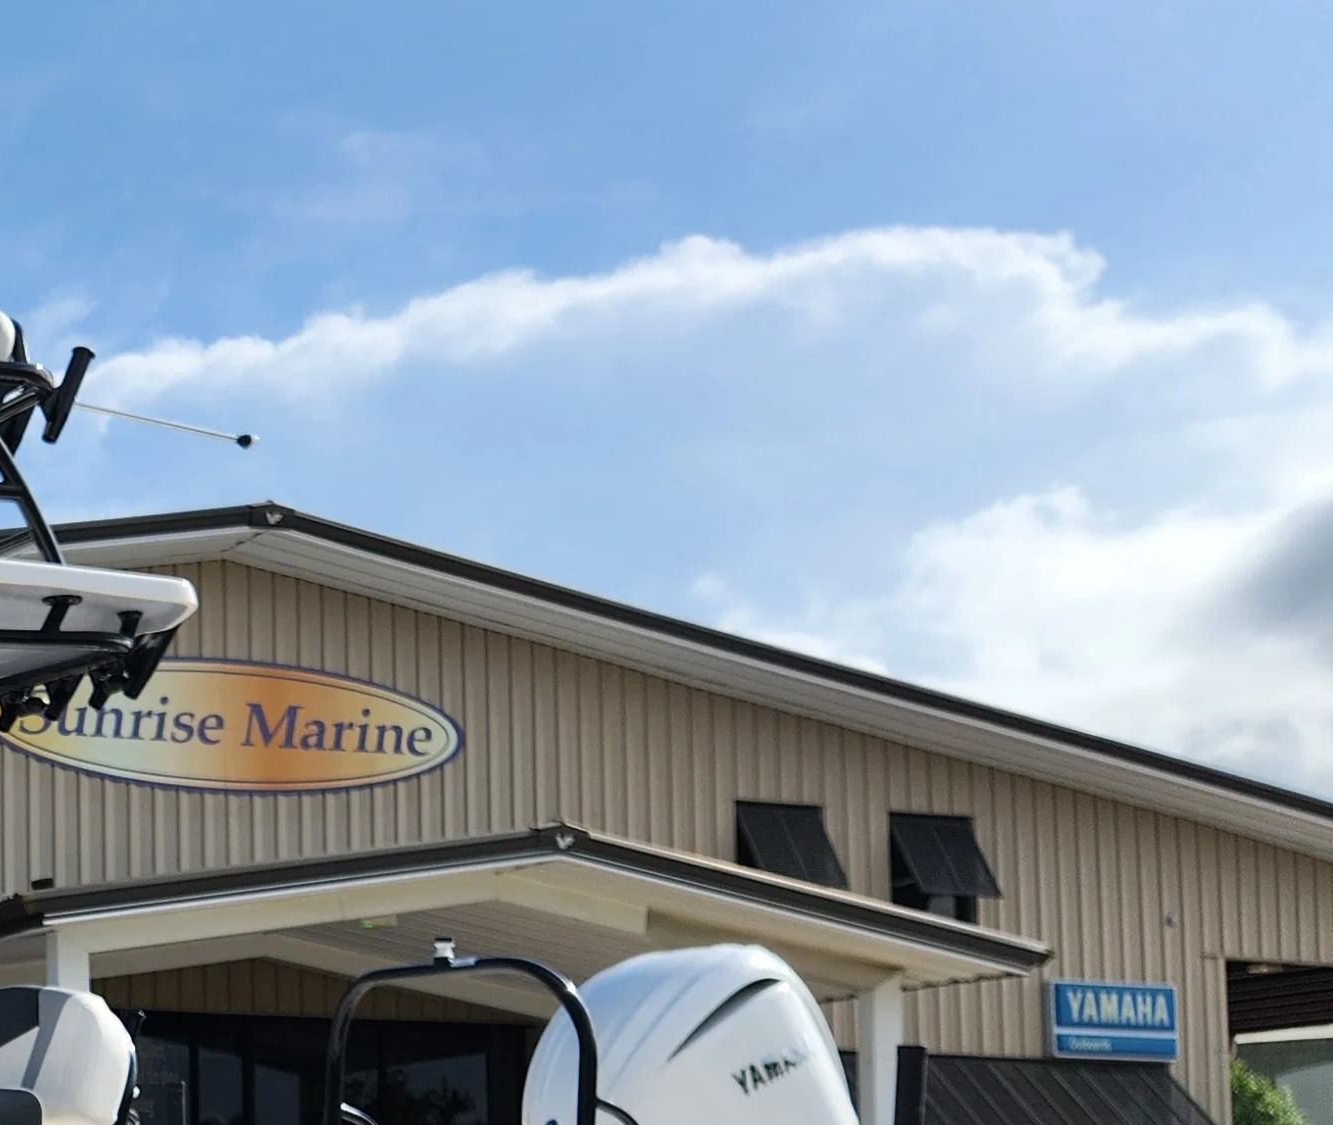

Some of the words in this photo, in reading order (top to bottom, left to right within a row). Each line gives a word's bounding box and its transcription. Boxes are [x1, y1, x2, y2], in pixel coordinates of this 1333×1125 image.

[240, 703, 433, 757] Marine
[1067, 989, 1170, 1027] YAMAHA
[731, 1057, 799, 1095] YAMA
